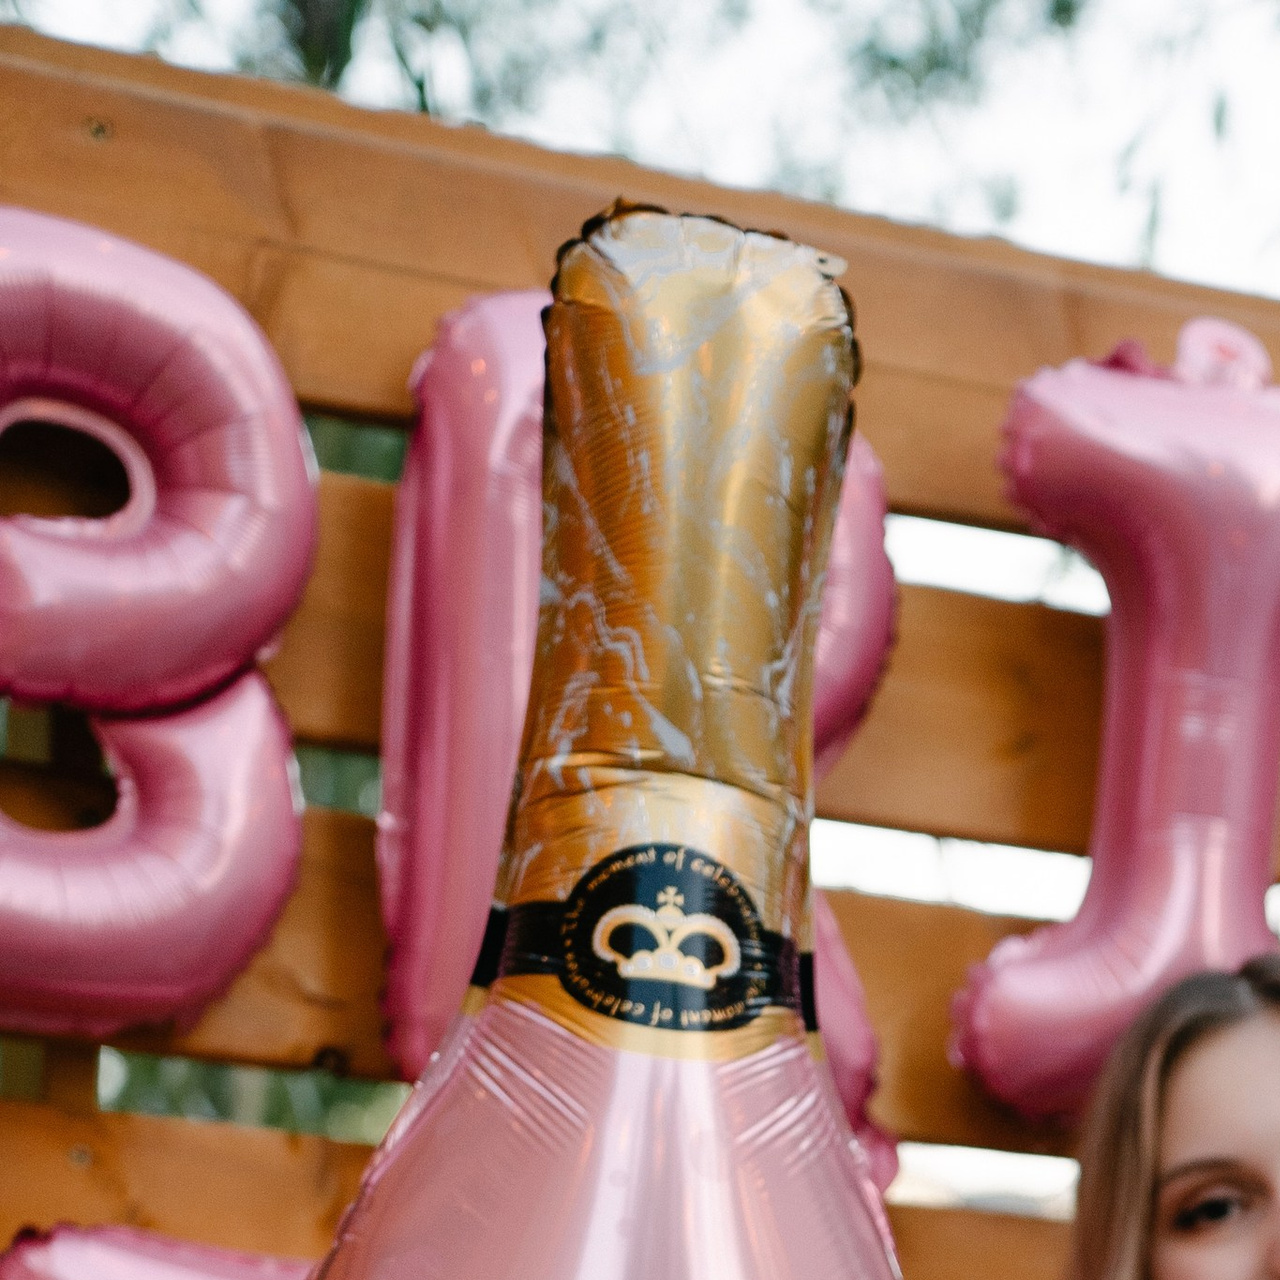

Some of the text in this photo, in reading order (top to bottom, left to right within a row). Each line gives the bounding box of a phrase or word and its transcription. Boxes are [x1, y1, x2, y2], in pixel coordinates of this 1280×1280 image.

[587, 846, 656, 892] moment
[663, 846, 685, 872] of
[650, 1000, 673, 1026] of
[681, 1001, 745, 1027] moment
